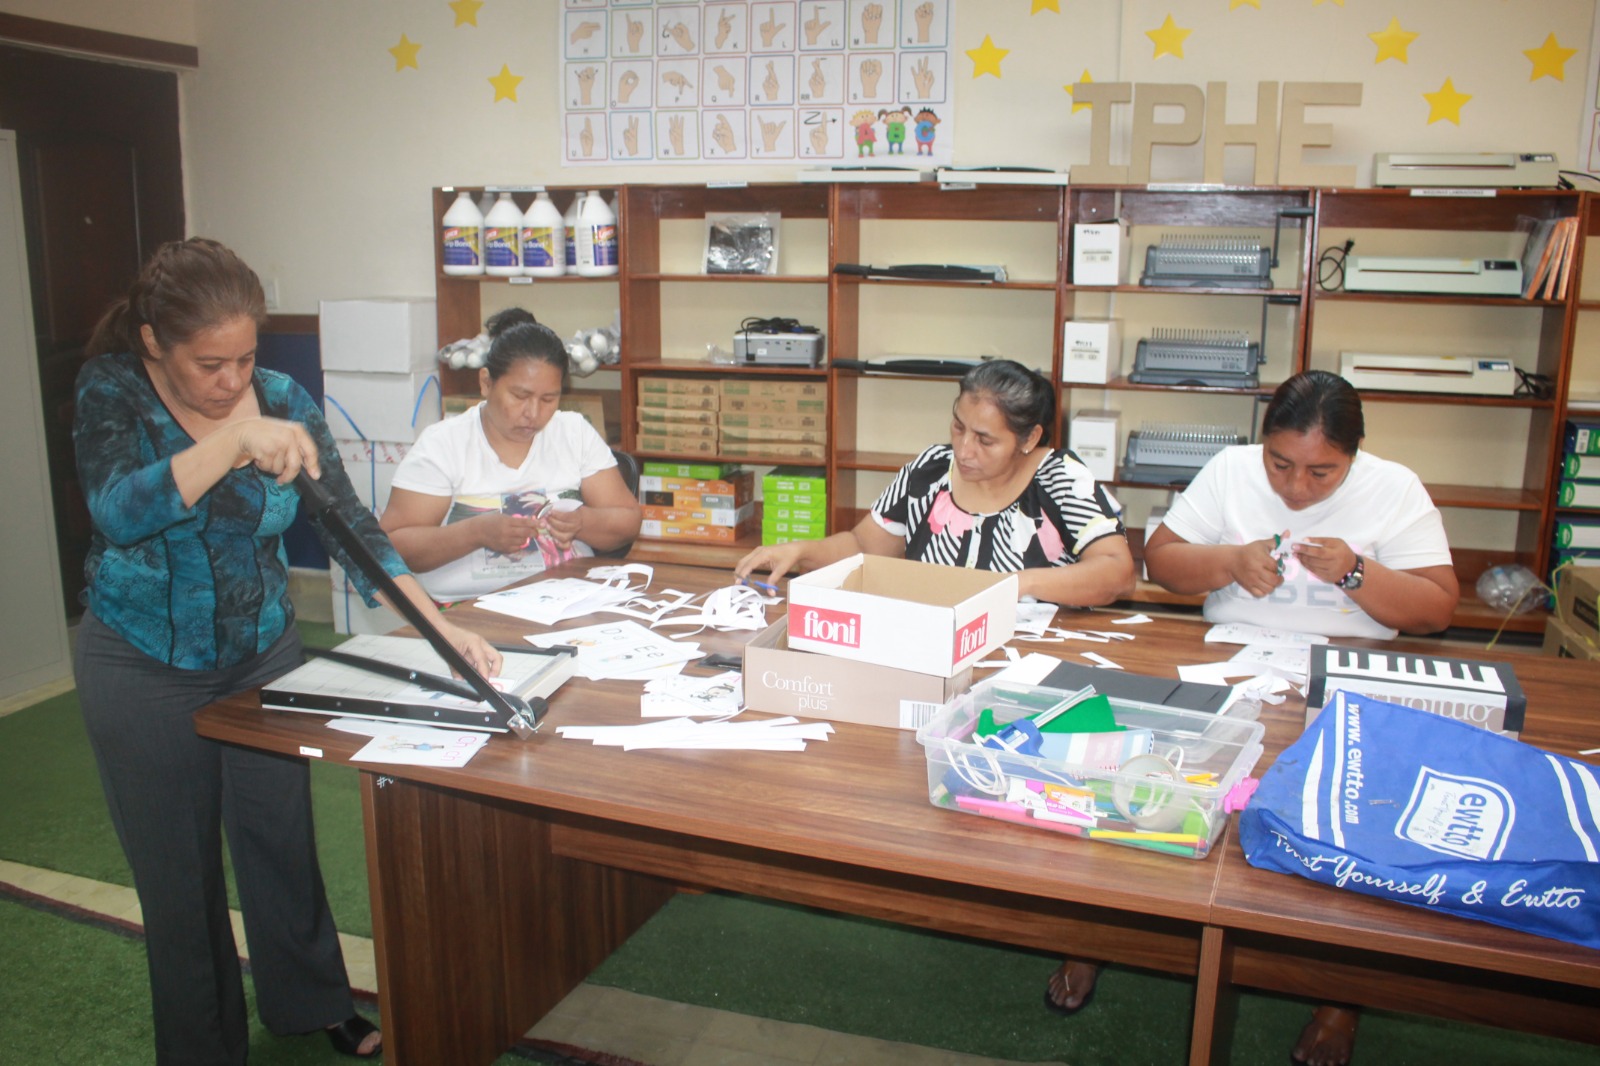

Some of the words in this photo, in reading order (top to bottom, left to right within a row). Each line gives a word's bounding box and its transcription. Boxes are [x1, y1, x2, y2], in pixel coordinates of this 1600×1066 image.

[857, 122, 877, 145] A
[888, 121, 906, 143] B
[914, 120, 936, 142] C
[1070, 81, 1363, 185] IPHE
[803, 609, 858, 645] fioni
[960, 620, 986, 659] fioni
[762, 671, 835, 698] Comfort
[799, 694, 828, 712] plus
[1441, 793, 1487, 847] ewtto
[1333, 854, 1449, 905] Yourself
[1461, 879, 1487, 906] &
[1501, 879, 1585, 909] Ewtto
